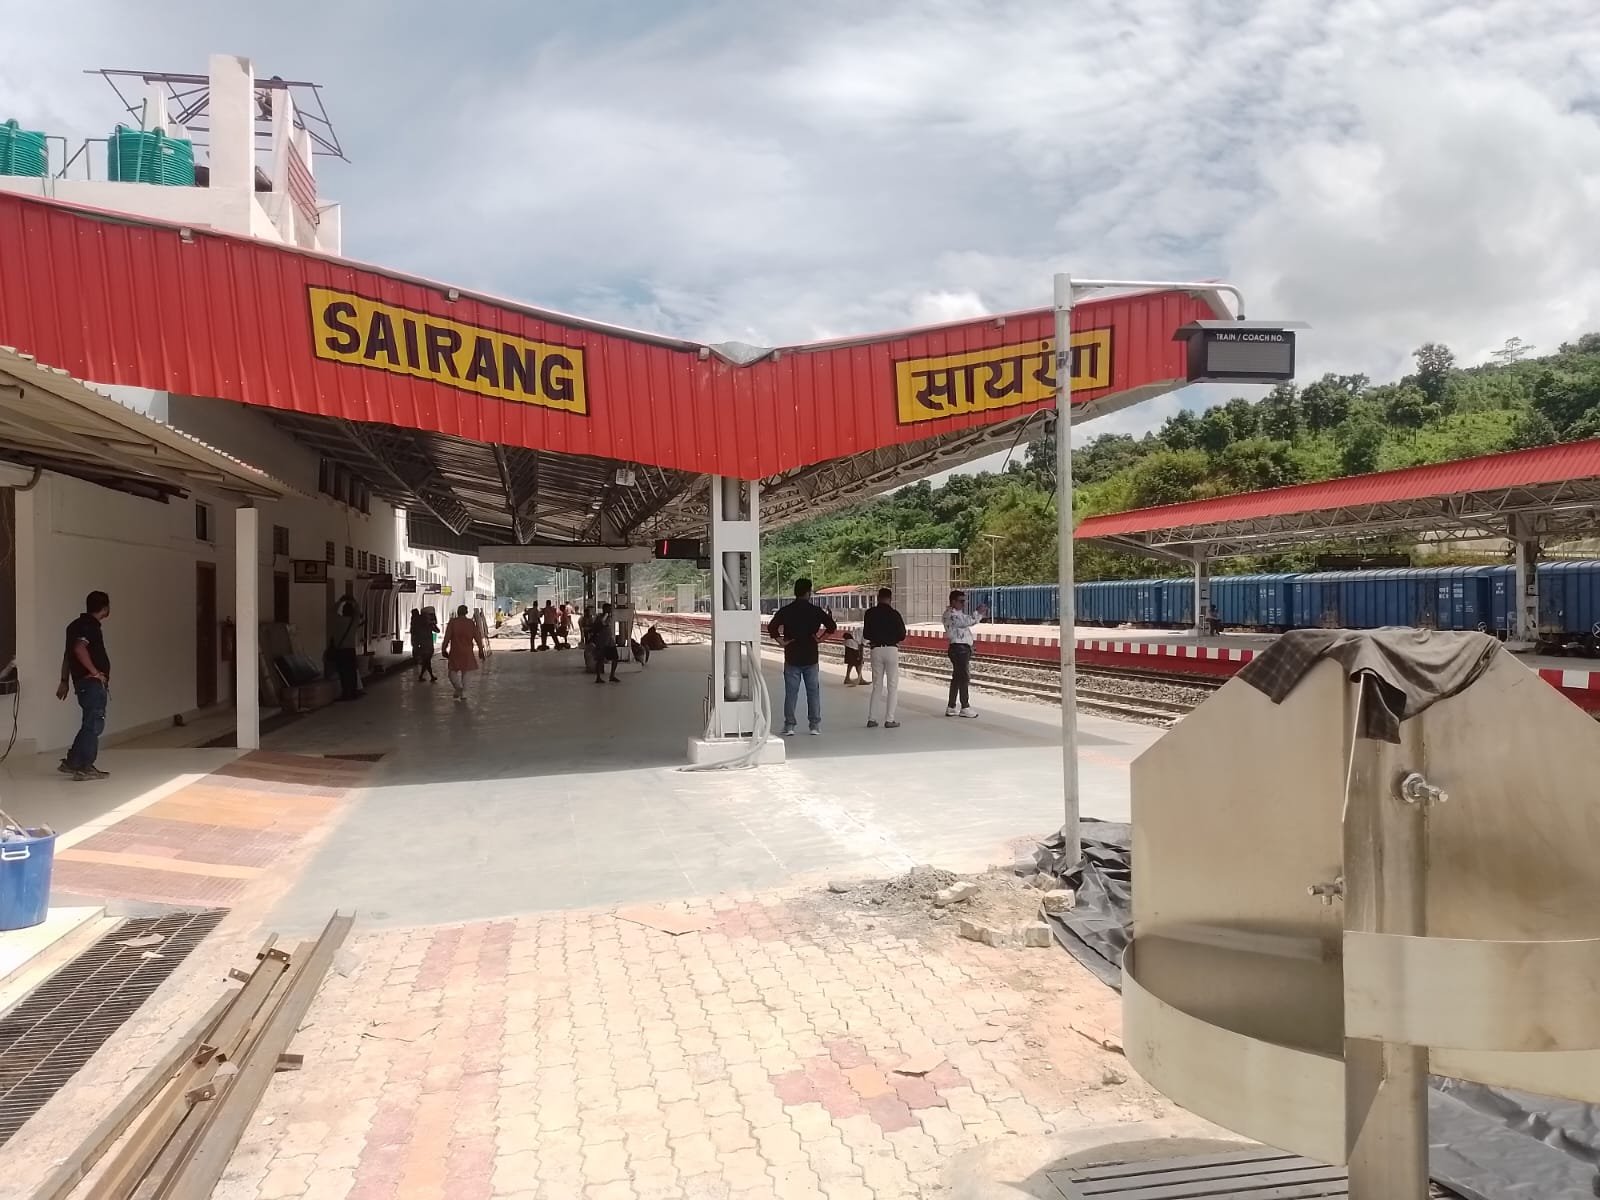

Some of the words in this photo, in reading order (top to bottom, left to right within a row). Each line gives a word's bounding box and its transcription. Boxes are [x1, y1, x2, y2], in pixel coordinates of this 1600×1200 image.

[323, 302, 575, 402] SAIRANG
[1216, 333, 1236, 341] TRAIN
[1270, 334, 1284, 342] NO.
